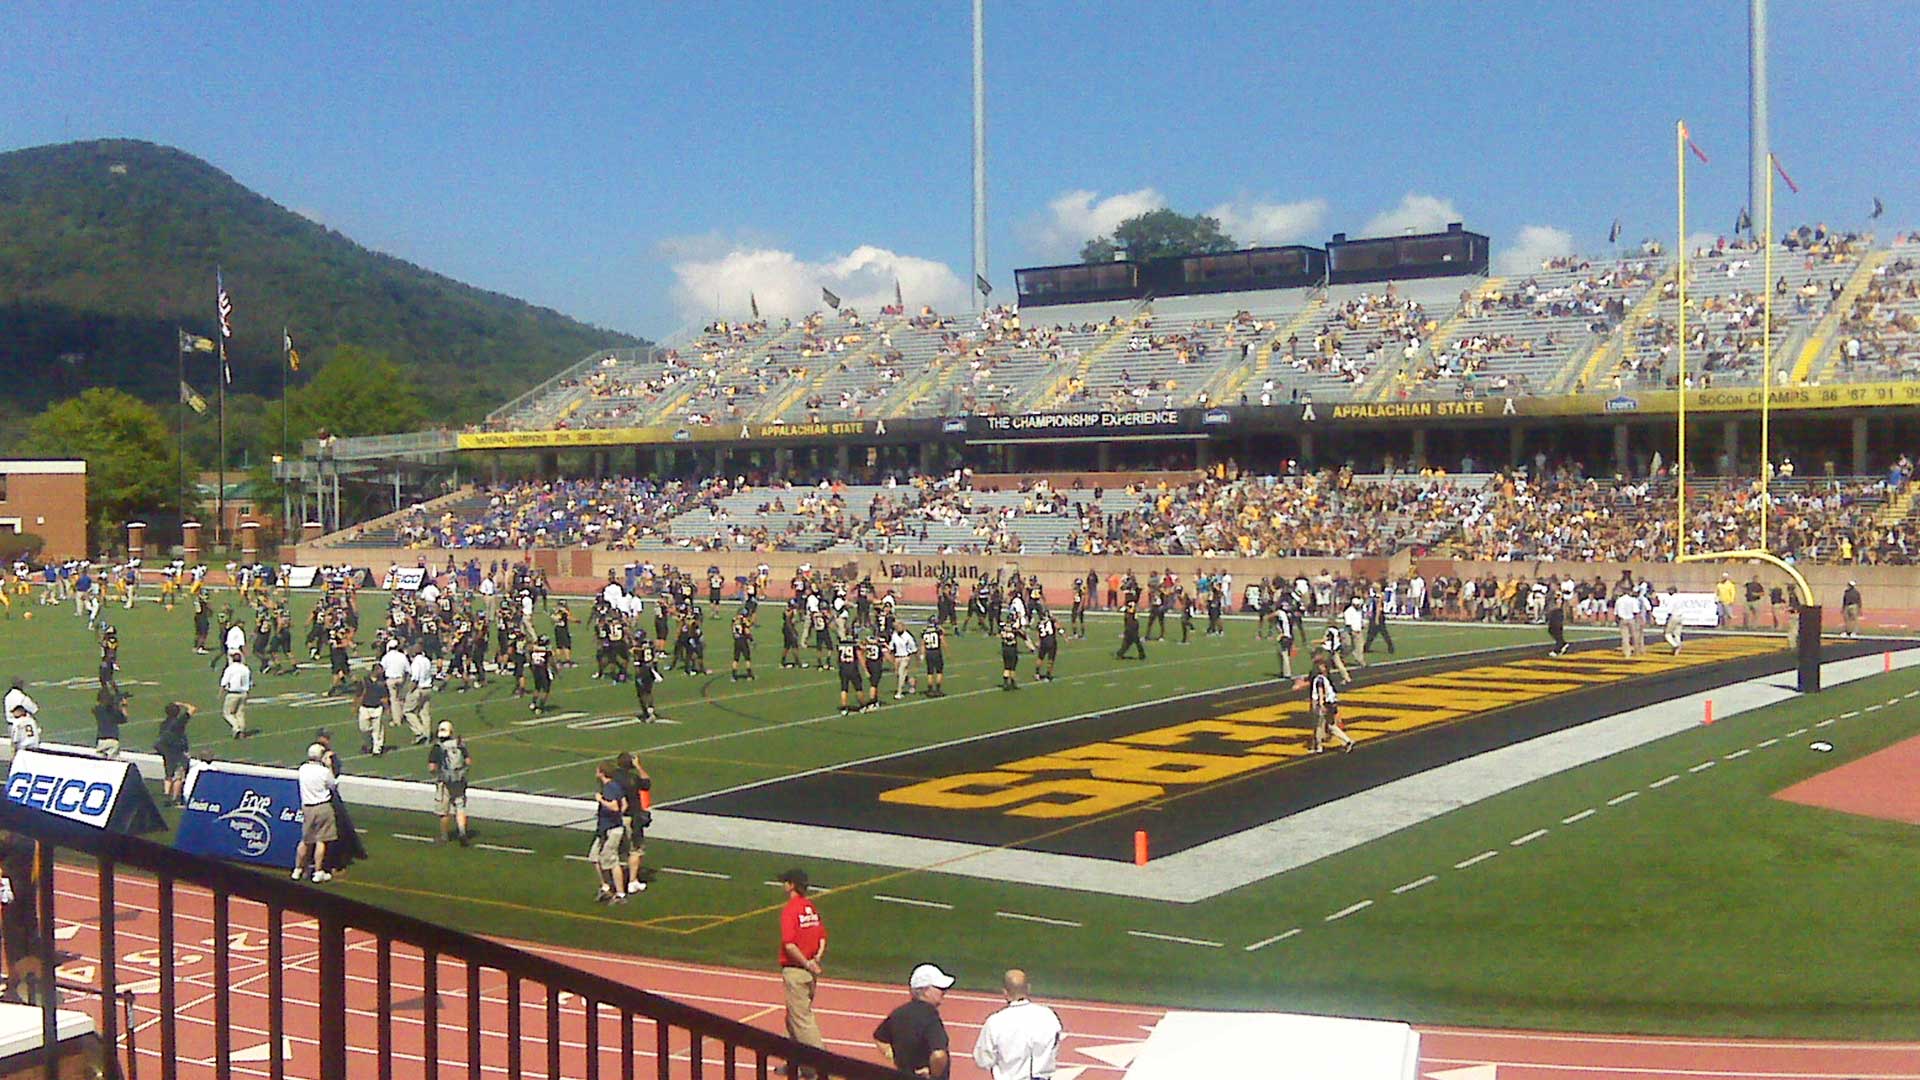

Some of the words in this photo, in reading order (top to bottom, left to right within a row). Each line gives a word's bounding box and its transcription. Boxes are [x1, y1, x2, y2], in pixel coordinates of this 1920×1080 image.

[1333, 403, 1431, 418] APPALACHIAN
[1438, 401, 1484, 415] STATE
[761, 423, 828, 437] APPALACHIAN
[832, 422, 864, 434] STATE
[986, 416, 1010, 430] THE
[1012, 413, 1099, 429] CHAMPIONSHIP
[1102, 411, 1178, 426] EXPERIENCE
[6, 772, 113, 816] GEICO
